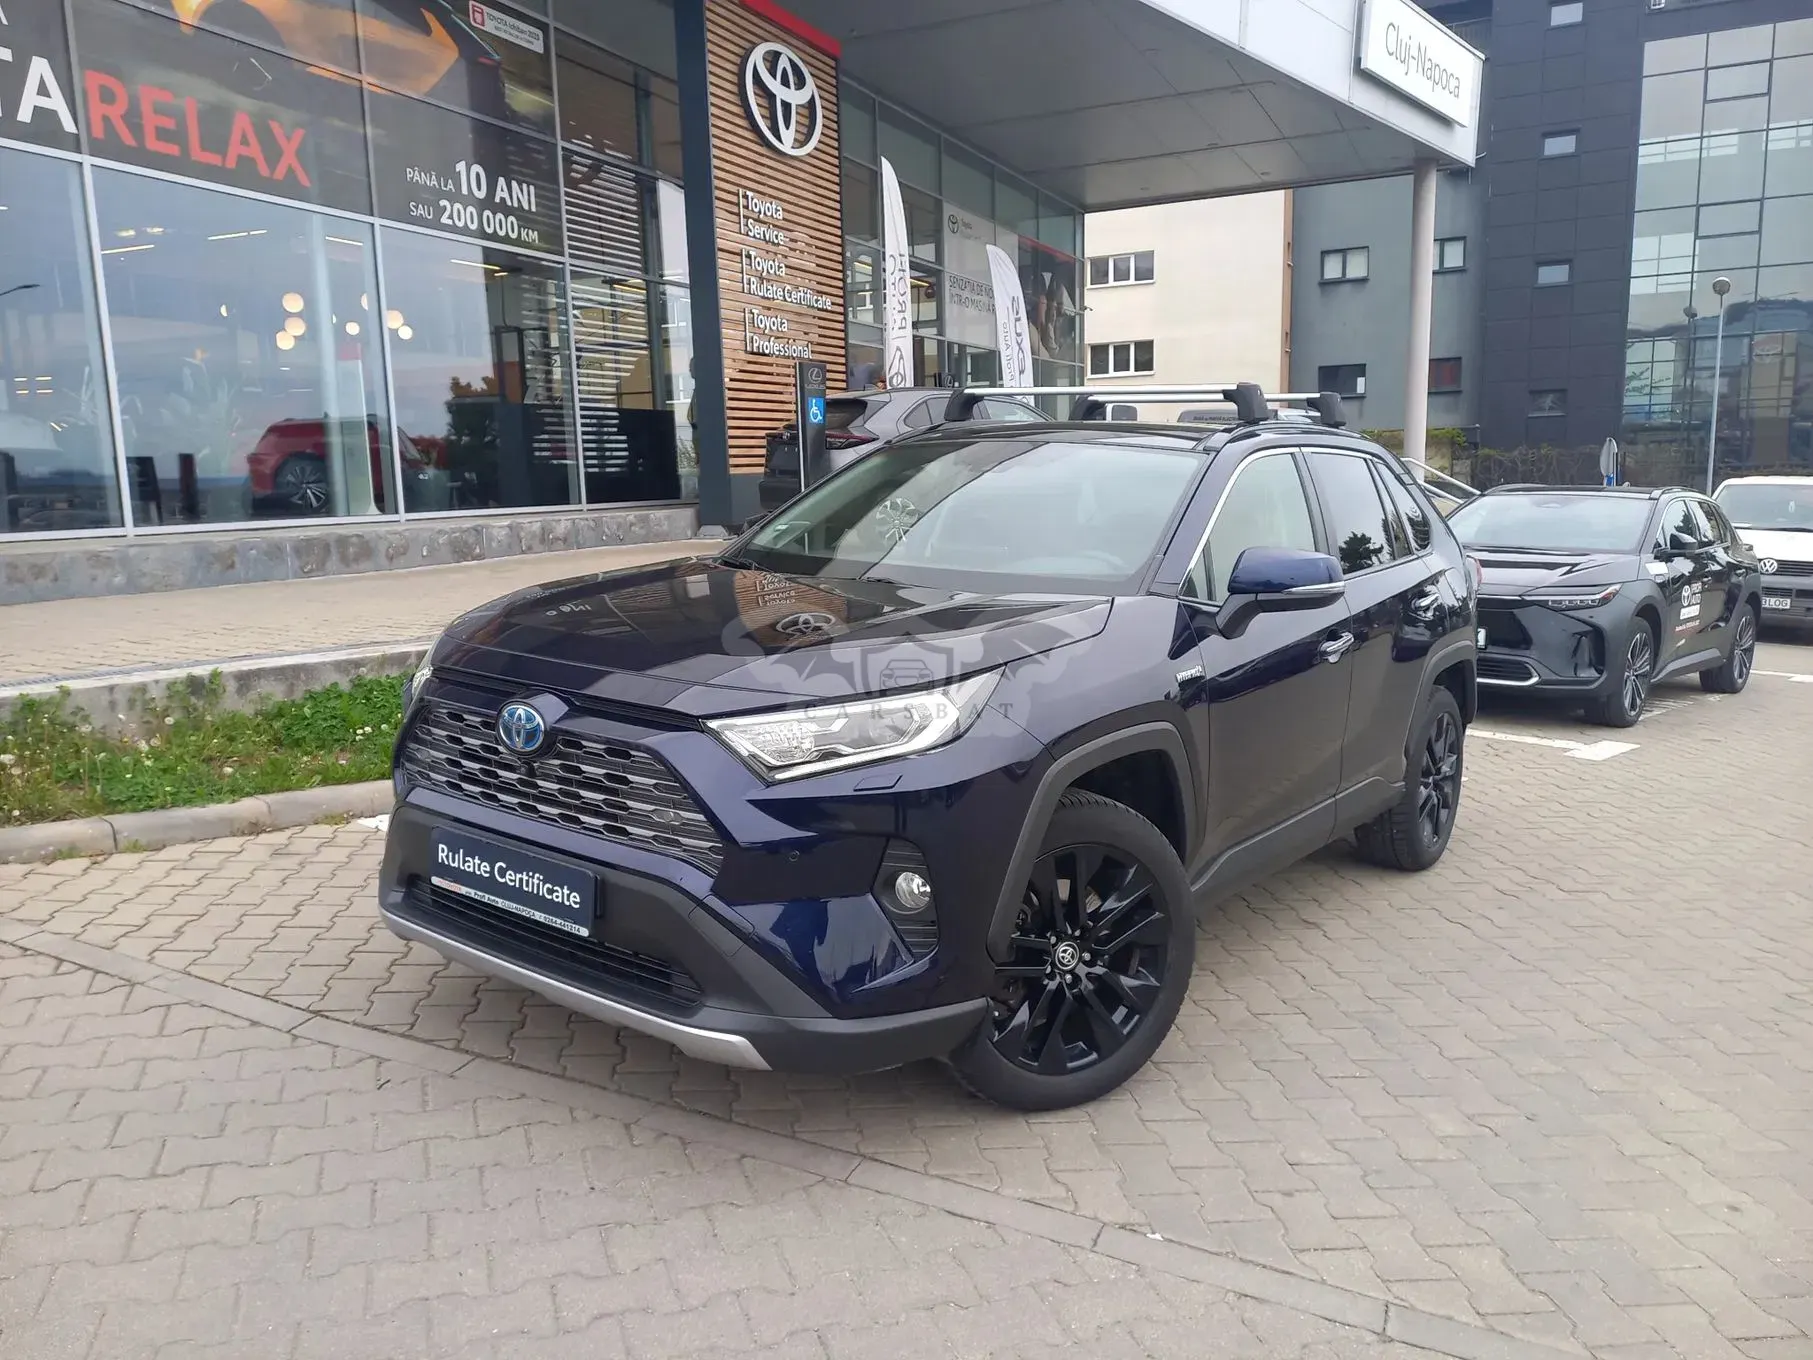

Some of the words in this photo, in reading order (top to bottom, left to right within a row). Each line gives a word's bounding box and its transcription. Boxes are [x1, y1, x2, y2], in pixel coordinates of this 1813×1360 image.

[1385, 22, 1461, 99] Cluj-Napoca
[84, 69, 311, 188] RELAX
[406, 167, 439, 189] PÂNĂ
[440, 178, 456, 193] LA
[455, 160, 487, 200] 10
[494, 176, 537, 212] ANI
[409, 201, 433, 219] SAU
[439, 199, 478, 230] 200
[482, 209, 518, 239] 000
[520, 227, 538, 244] KM
[746, 191, 783, 219] Toyota
[747, 219, 785, 245] Service
[749, 251, 786, 276] Toyota
[751, 277, 783, 301] Rulate
[784, 283, 832, 310] Certificate
[752, 309, 788, 334] Toyota
[752, 334, 813, 360] Professional
[438, 843, 491, 878] Rulate
[494, 862, 581, 909] Certificate
